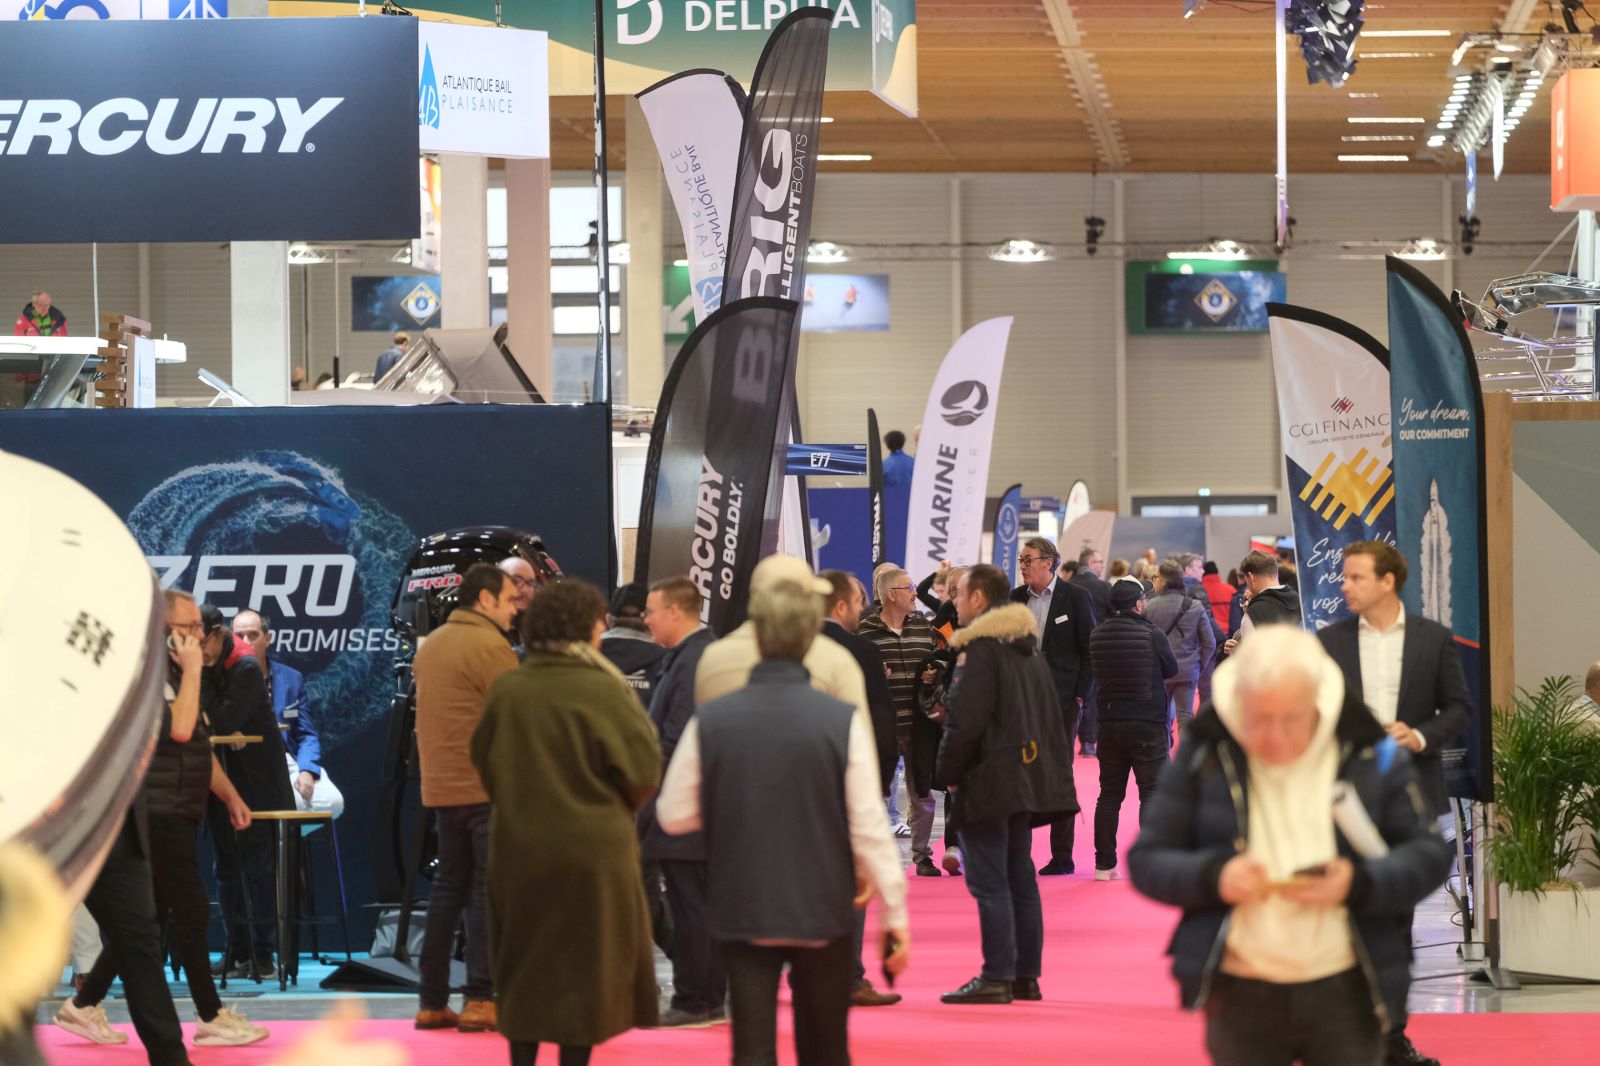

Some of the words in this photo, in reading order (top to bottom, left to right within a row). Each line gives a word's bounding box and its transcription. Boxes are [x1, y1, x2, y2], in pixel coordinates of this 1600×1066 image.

[443, 75, 493, 93] ATLANTIQUE
[495, 80, 512, 93] BAIL
[442, 94, 512, 113] PLAISANCE
[1399, 397, 1428, 426] Your
[1322, 413, 1390, 434] FINANC
[1400, 430, 1415, 440] OUR
[1416, 428, 1470, 440] COMMITMENT
[810, 452, 831, 468] E77
[927, 443, 958, 563] MARINE
[720, 567, 734, 600] GO
